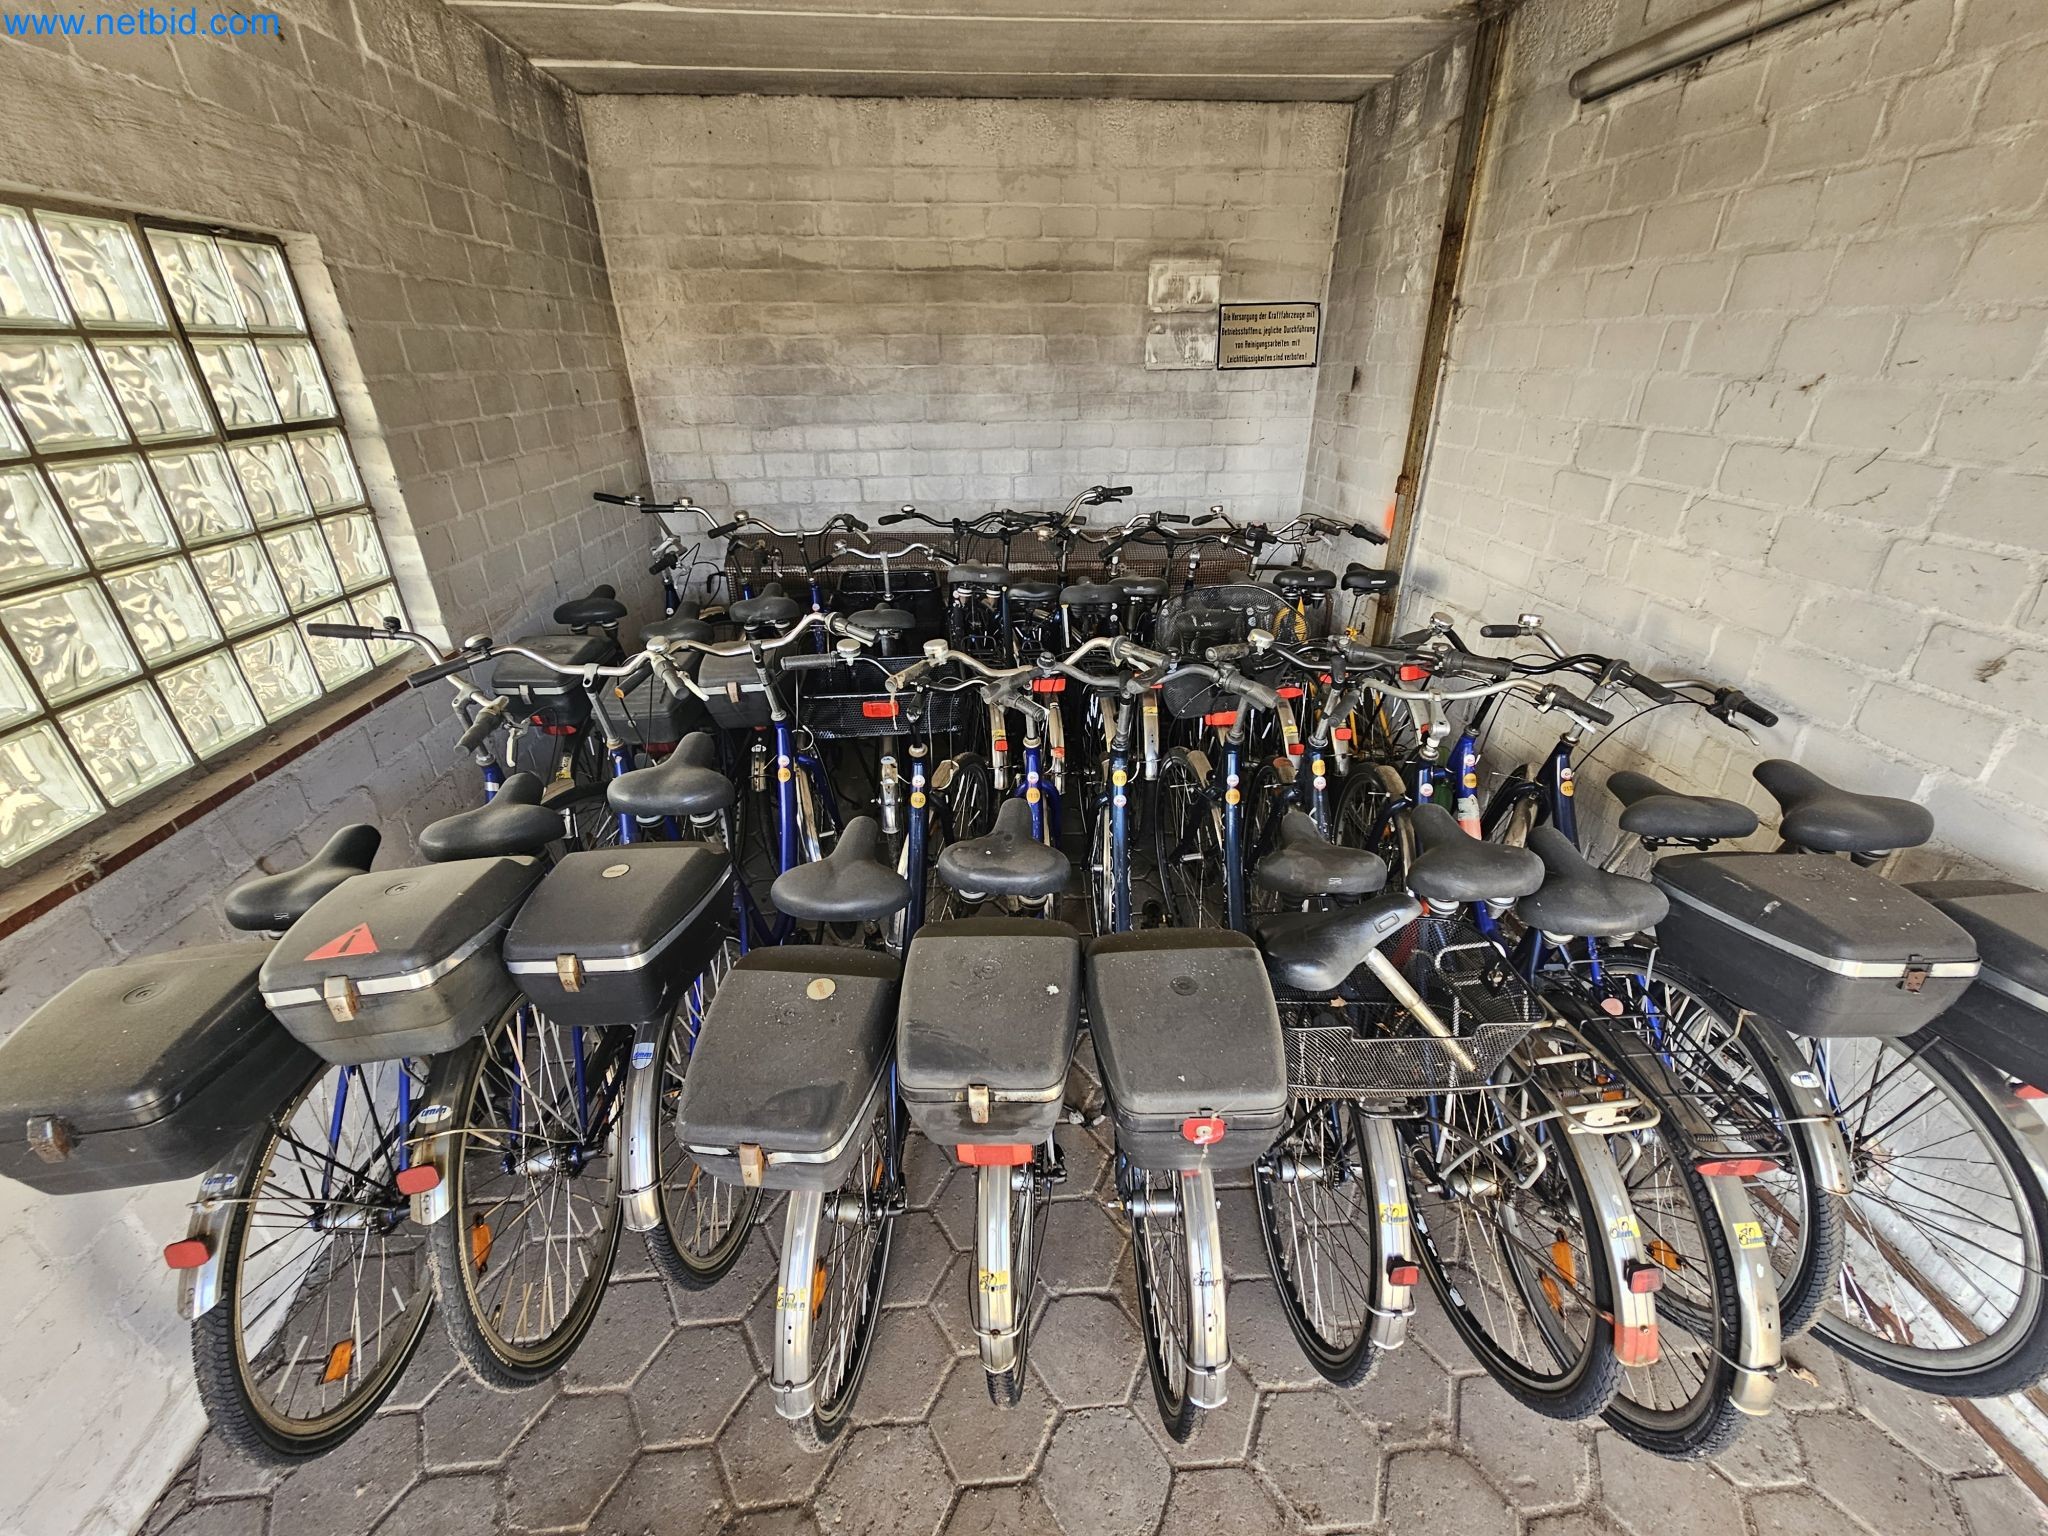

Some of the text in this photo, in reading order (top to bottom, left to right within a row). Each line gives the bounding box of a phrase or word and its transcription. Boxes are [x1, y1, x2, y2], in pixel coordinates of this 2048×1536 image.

[1223, 313, 1231, 321] Die
[1258, 311, 1267, 320] der
[1268, 311, 1305, 321] Kraftfahrzeuge
